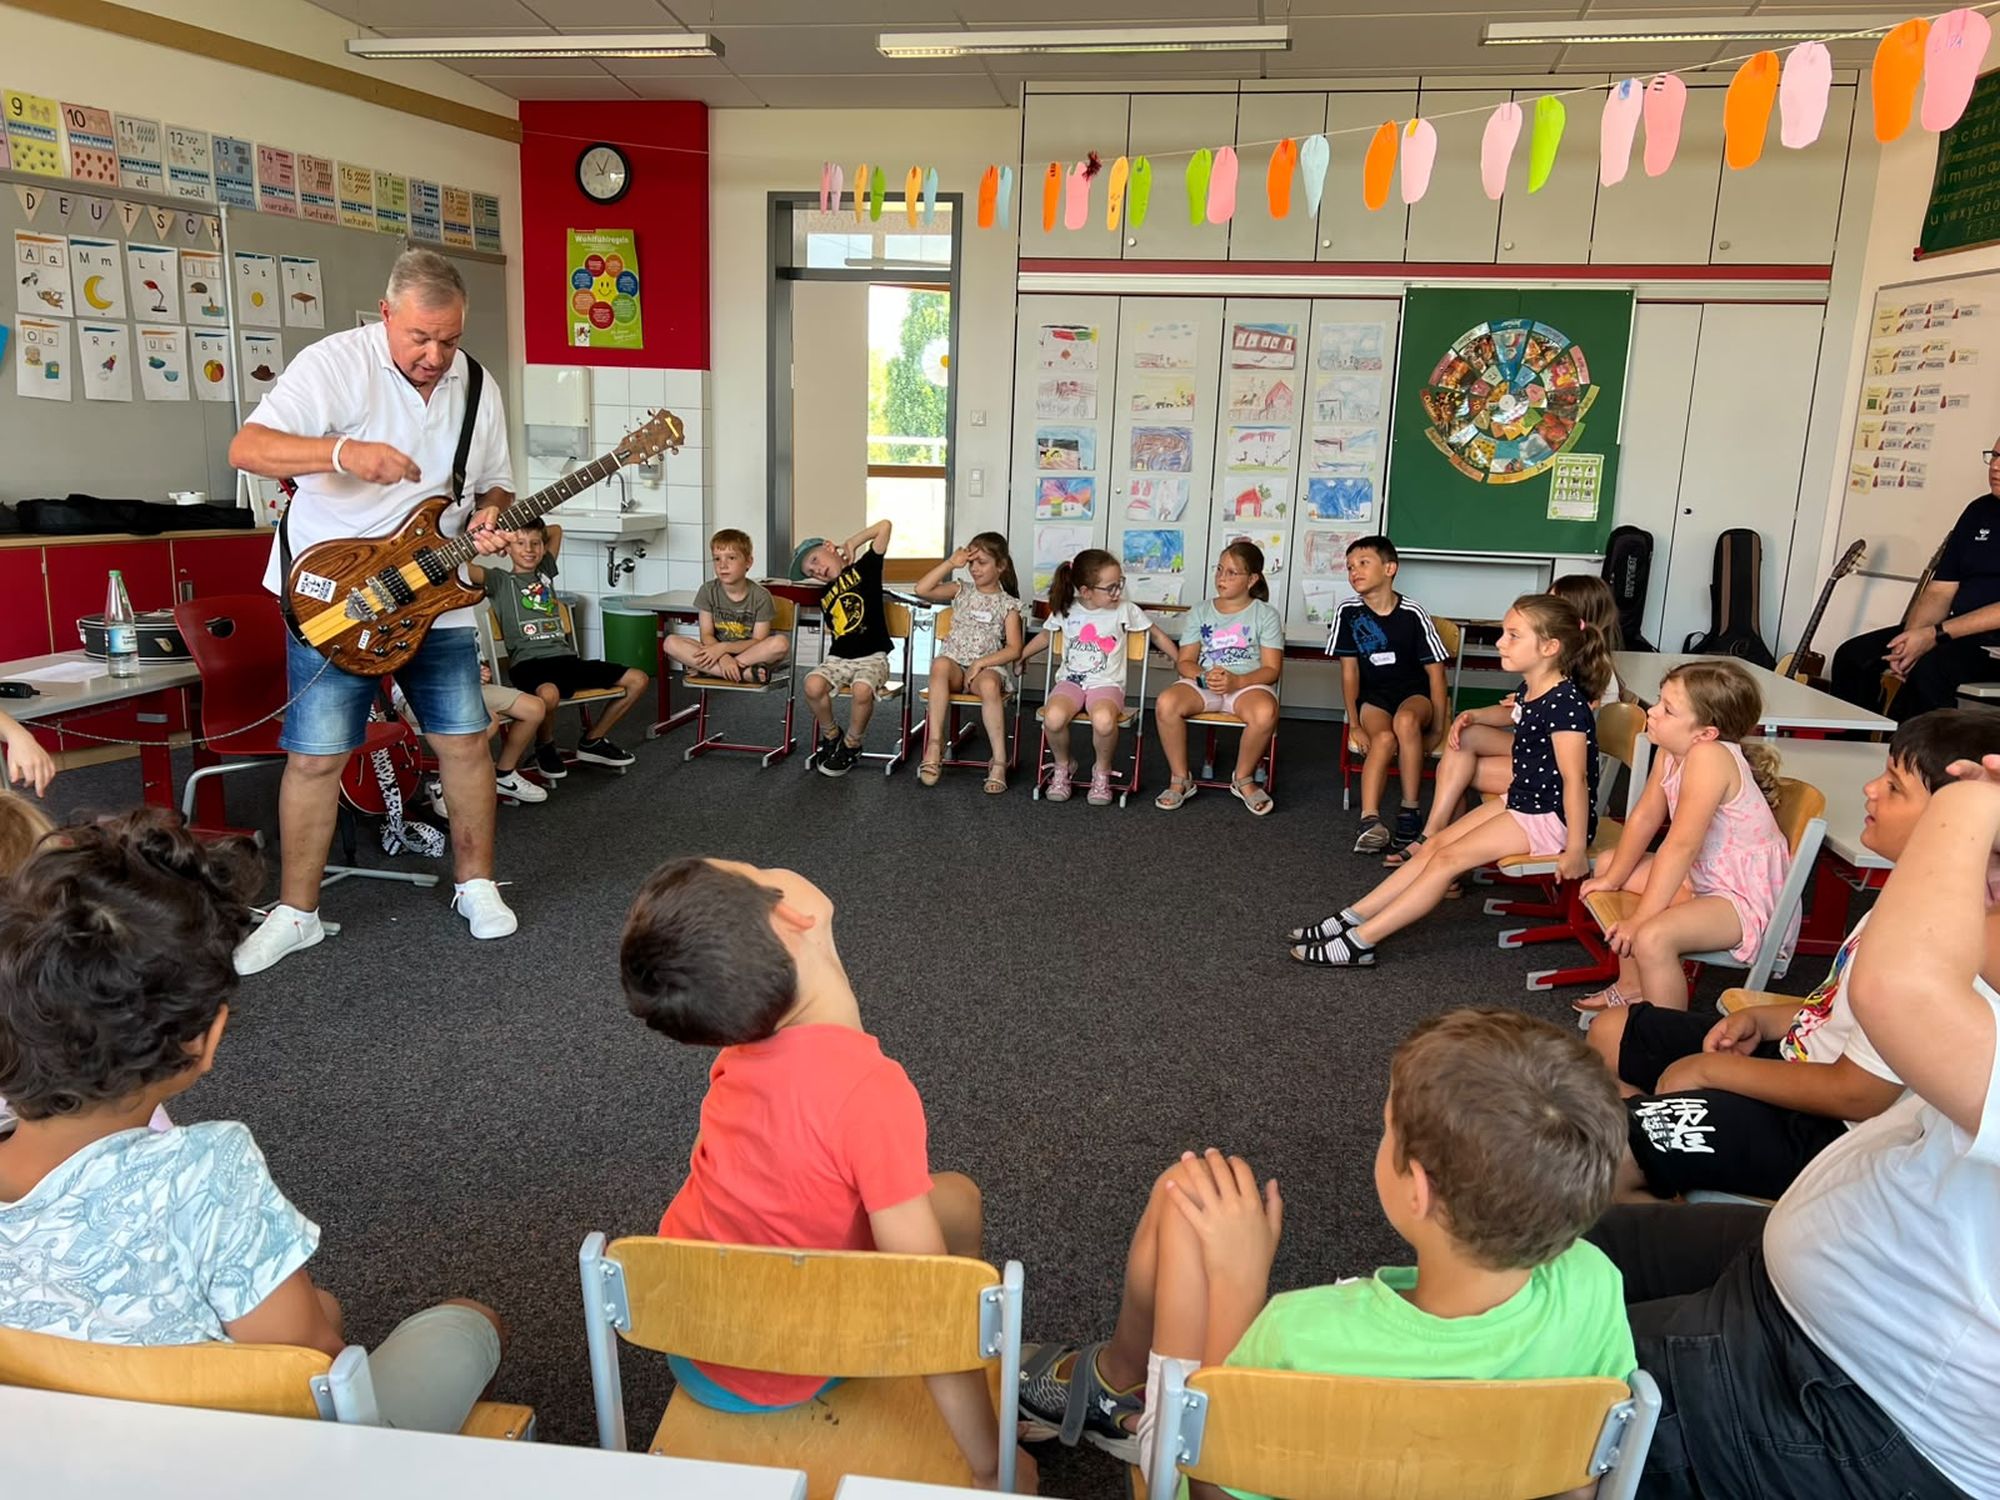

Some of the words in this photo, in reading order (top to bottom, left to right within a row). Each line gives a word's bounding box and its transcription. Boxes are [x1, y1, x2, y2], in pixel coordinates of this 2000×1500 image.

[11, 96, 23, 117] 9
[67, 108, 86, 129] 10
[119, 119, 135, 136] 11
[169, 130, 185, 147] 12
[215, 140, 230, 156] 13
[260, 149, 274, 165] 14
[301, 158, 314, 173] 15
[341, 167, 353, 181] 16
[135, 175, 150, 190] elf
[377, 176, 389, 188] 17
[412, 183, 423, 197] 18
[24, 249, 34, 260] A
[49, 255, 59, 264] a
[79, 251, 91, 265] M
[100, 257, 113, 267] m
[138, 258, 146, 270] L
[242, 263, 250, 276] S
[289, 268, 297, 280] T
[307, 273, 313, 282] t
[27, 330, 37, 342] O
[47, 335, 54, 344] o
[92, 335, 100, 347] R
[149, 338, 157, 350] U
[201, 341, 209, 351] B
[216, 342, 223, 352] b
[251, 345, 258, 355] H
